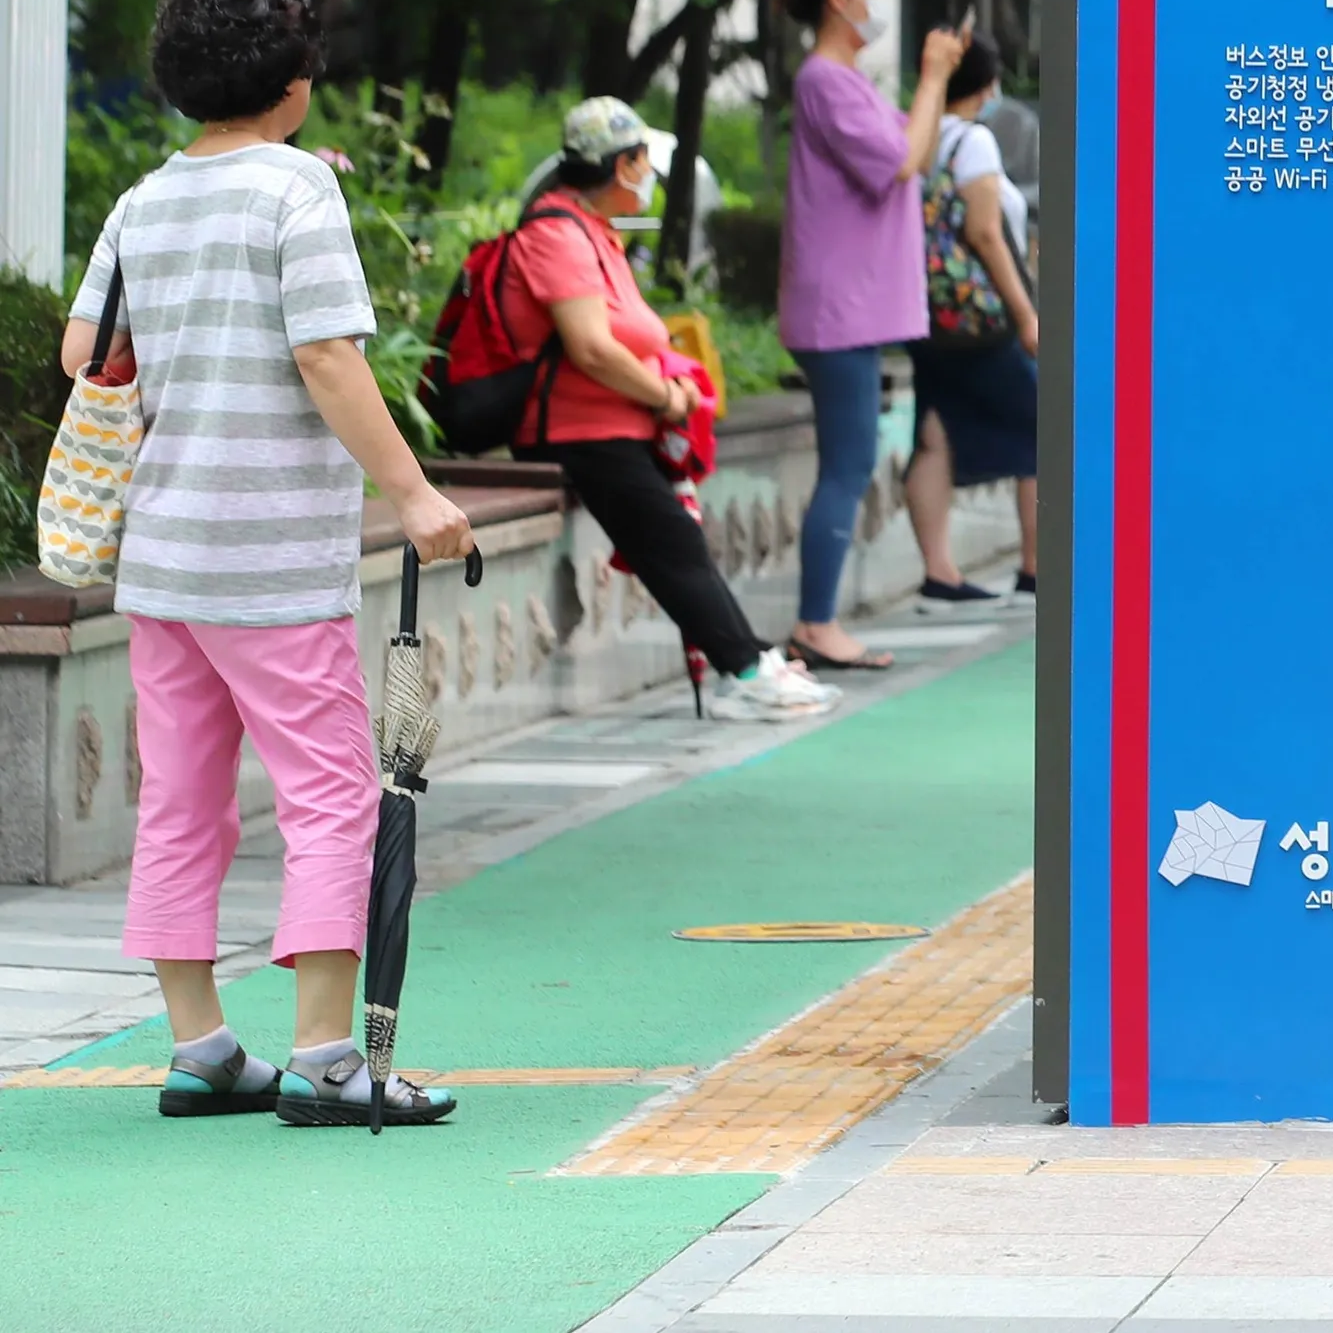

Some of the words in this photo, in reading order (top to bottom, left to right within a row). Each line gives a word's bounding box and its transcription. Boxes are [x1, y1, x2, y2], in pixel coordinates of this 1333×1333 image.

[1225, 43, 1309, 71] 버스정보
[1224, 74, 1308, 102] 공기청정
[1224, 104, 1287, 132] 자외선
[1224, 135, 1289, 161] 스마트
[1223, 166, 1268, 193] 공공
[1274, 167, 1328, 190] Wi-Fi
